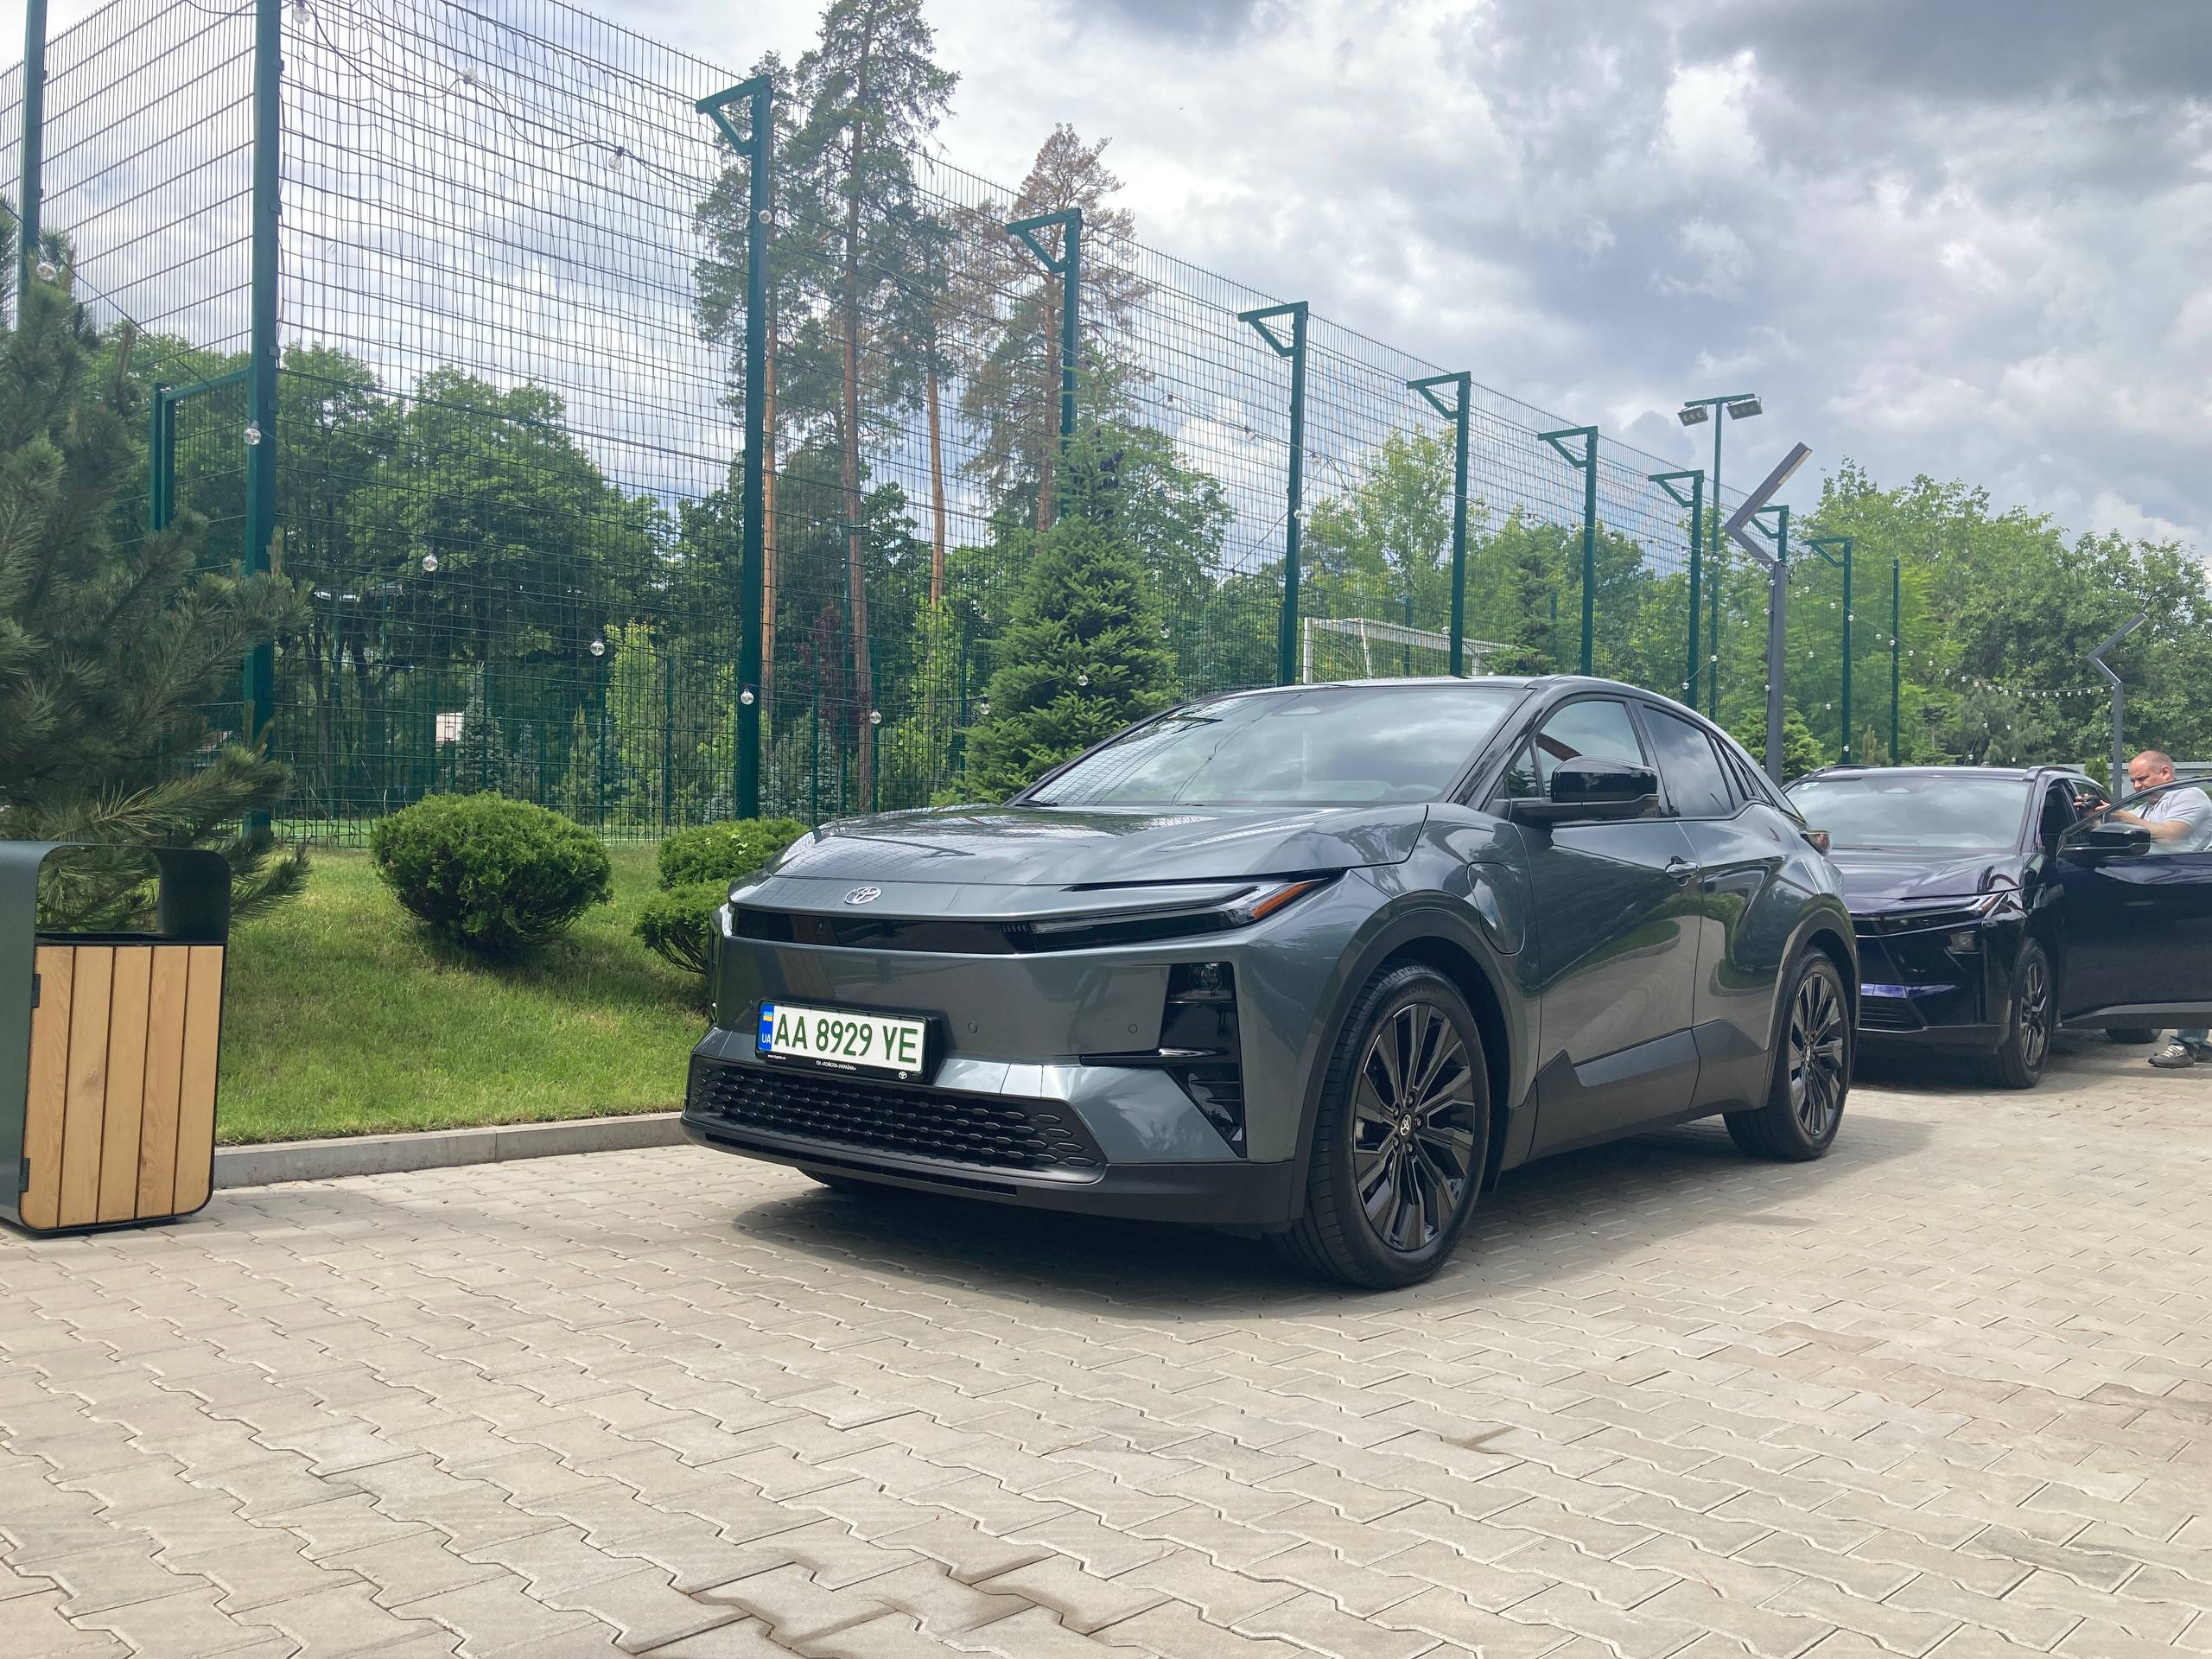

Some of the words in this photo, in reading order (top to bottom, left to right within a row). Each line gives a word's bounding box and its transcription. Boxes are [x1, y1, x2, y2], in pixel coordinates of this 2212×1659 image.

[761, 1033, 772, 1044] UA
[774, 1014, 808, 1049] AA
[816, 1018, 873, 1057] 8929
[882, 1025, 918, 1064] YE
